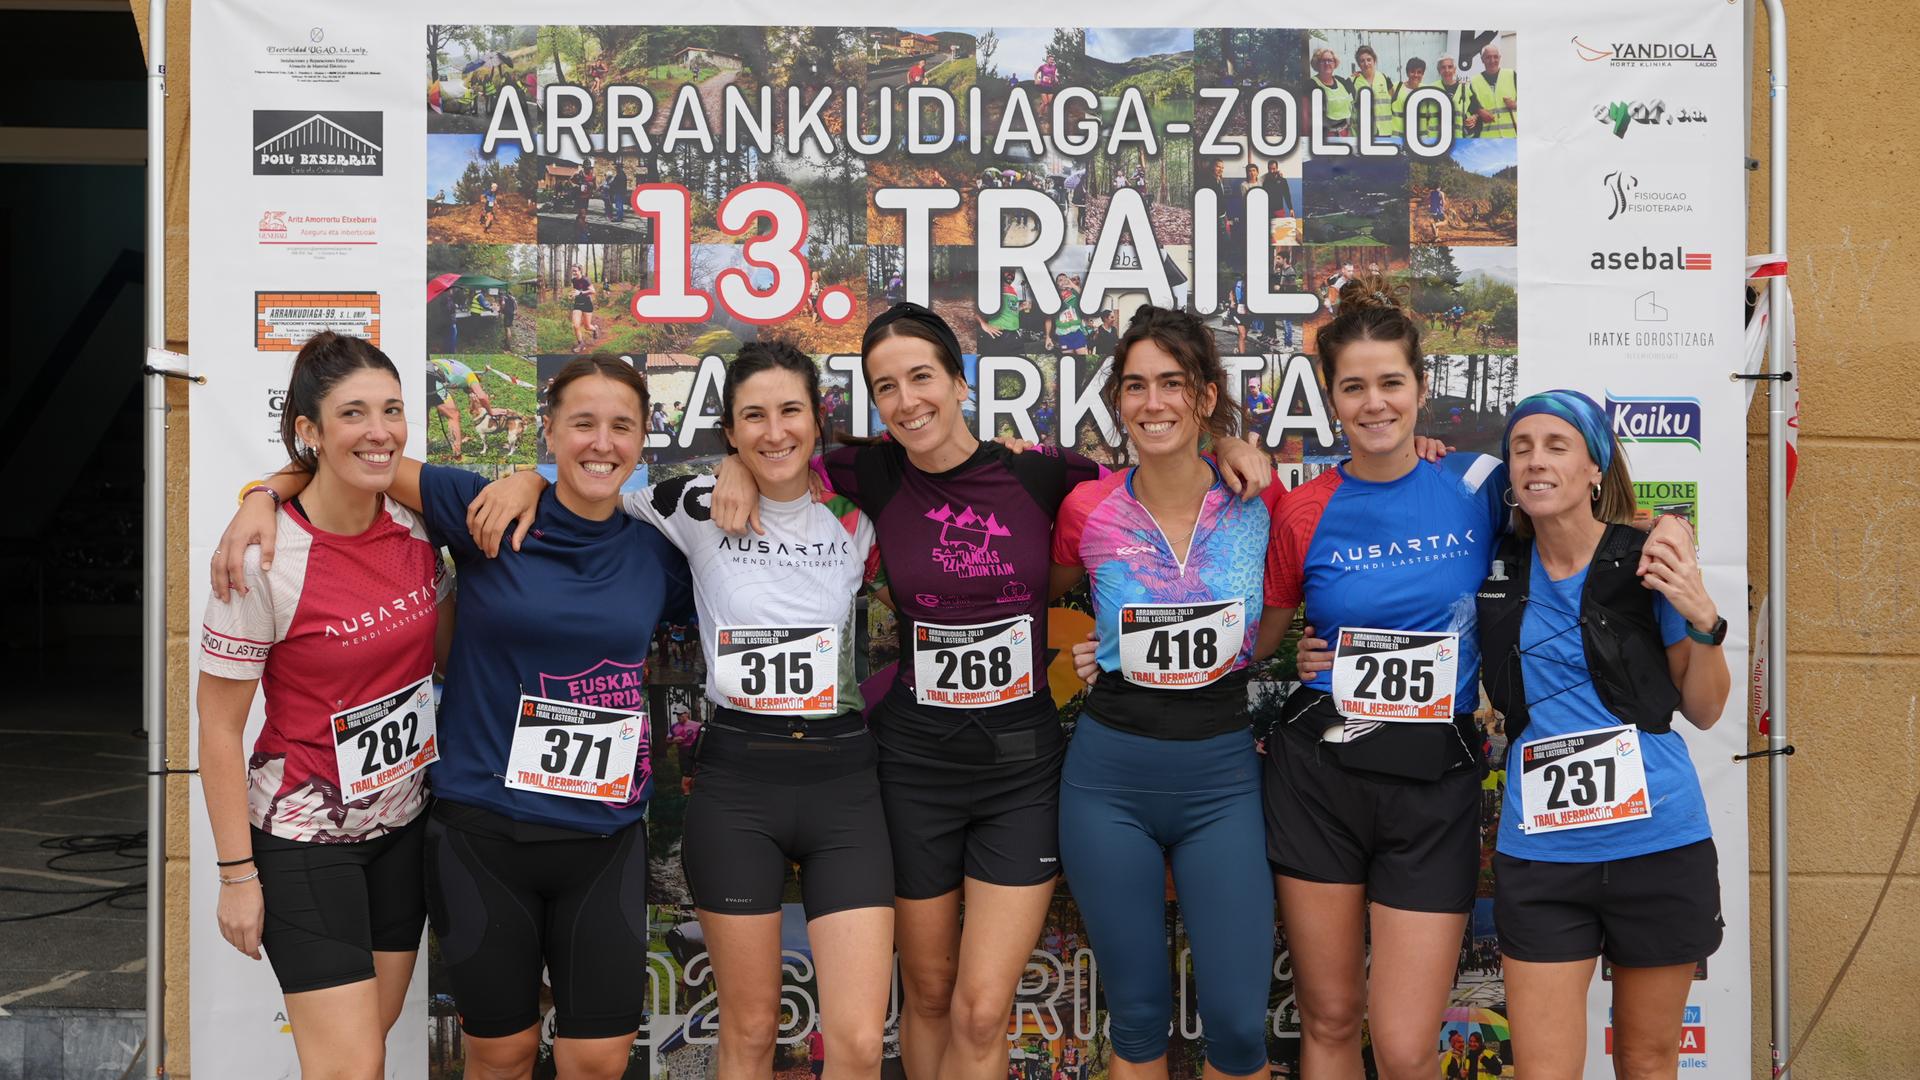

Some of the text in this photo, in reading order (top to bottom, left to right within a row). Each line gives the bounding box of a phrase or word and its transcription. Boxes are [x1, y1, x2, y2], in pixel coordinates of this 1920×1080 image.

[1611, 43, 1716, 59] YANDIOLA
[483, 85, 1454, 156] ARRANKUDIAGA-ZOLLO
[1634, 192, 1687, 200] FISIOUGAO
[1628, 204, 1693, 213] FISIOTERAPIA
[631, 181, 1319, 324] 13. TRAIL
[1590, 246, 1686, 270] asebal
[1589, 332, 1715, 346] IRATXE GOROSTIZAGA
[1613, 403, 1690, 442] Kaiku
[732, 556, 845, 568] MENDI LASTERKETA
[1344, 549, 1470, 572] MENDI LASTERKETA
[1123, 610, 1136, 623] 13.
[1151, 615, 1184, 623] LASTERKETA
[342, 630, 381, 648] MENDI
[720, 631, 732, 645] 13.
[731, 637, 779, 645] TRAIL LASTERKETA
[917, 628, 929, 641] 13.
[943, 636, 975, 644] LASTERKETA
[1342, 633, 1353, 647] 13.
[1146, 627, 1218, 670] 418
[1366, 641, 1399, 650] LASTERKETA
[741, 651, 814, 696] 315
[935, 645, 1012, 691] 268
[568, 671, 641, 696] EUSKAL
[1131, 671, 1209, 685] TRAIL HERRIKOIA
[1353, 655, 1434, 703] 285
[727, 696, 805, 709] TRAIL HERRIKOIA
[926, 689, 1001, 704] TRAIL HERRIKOIA
[522, 702, 536, 717] 13.
[1341, 700, 1420, 718] TRAIL HERRIKOIA
[348, 709, 390, 729] TRAIL LASTERKETA
[535, 710, 585, 725] TRAIL LASTERKETA
[335, 718, 348, 733] 13.
[357, 711, 420, 777] 282
[540, 728, 613, 780] 371
[1524, 748, 1534, 762] 13.
[1533, 747, 1576, 760] TRAIL LASTERKETA
[350, 758, 415, 795] TRAIL HERRIKOIA
[517, 771, 598, 795] TRAIL HERRIKOIA
[1543, 756, 1616, 810] 237
[1533, 806, 1614, 828] TRAIL HERRIKOIA
